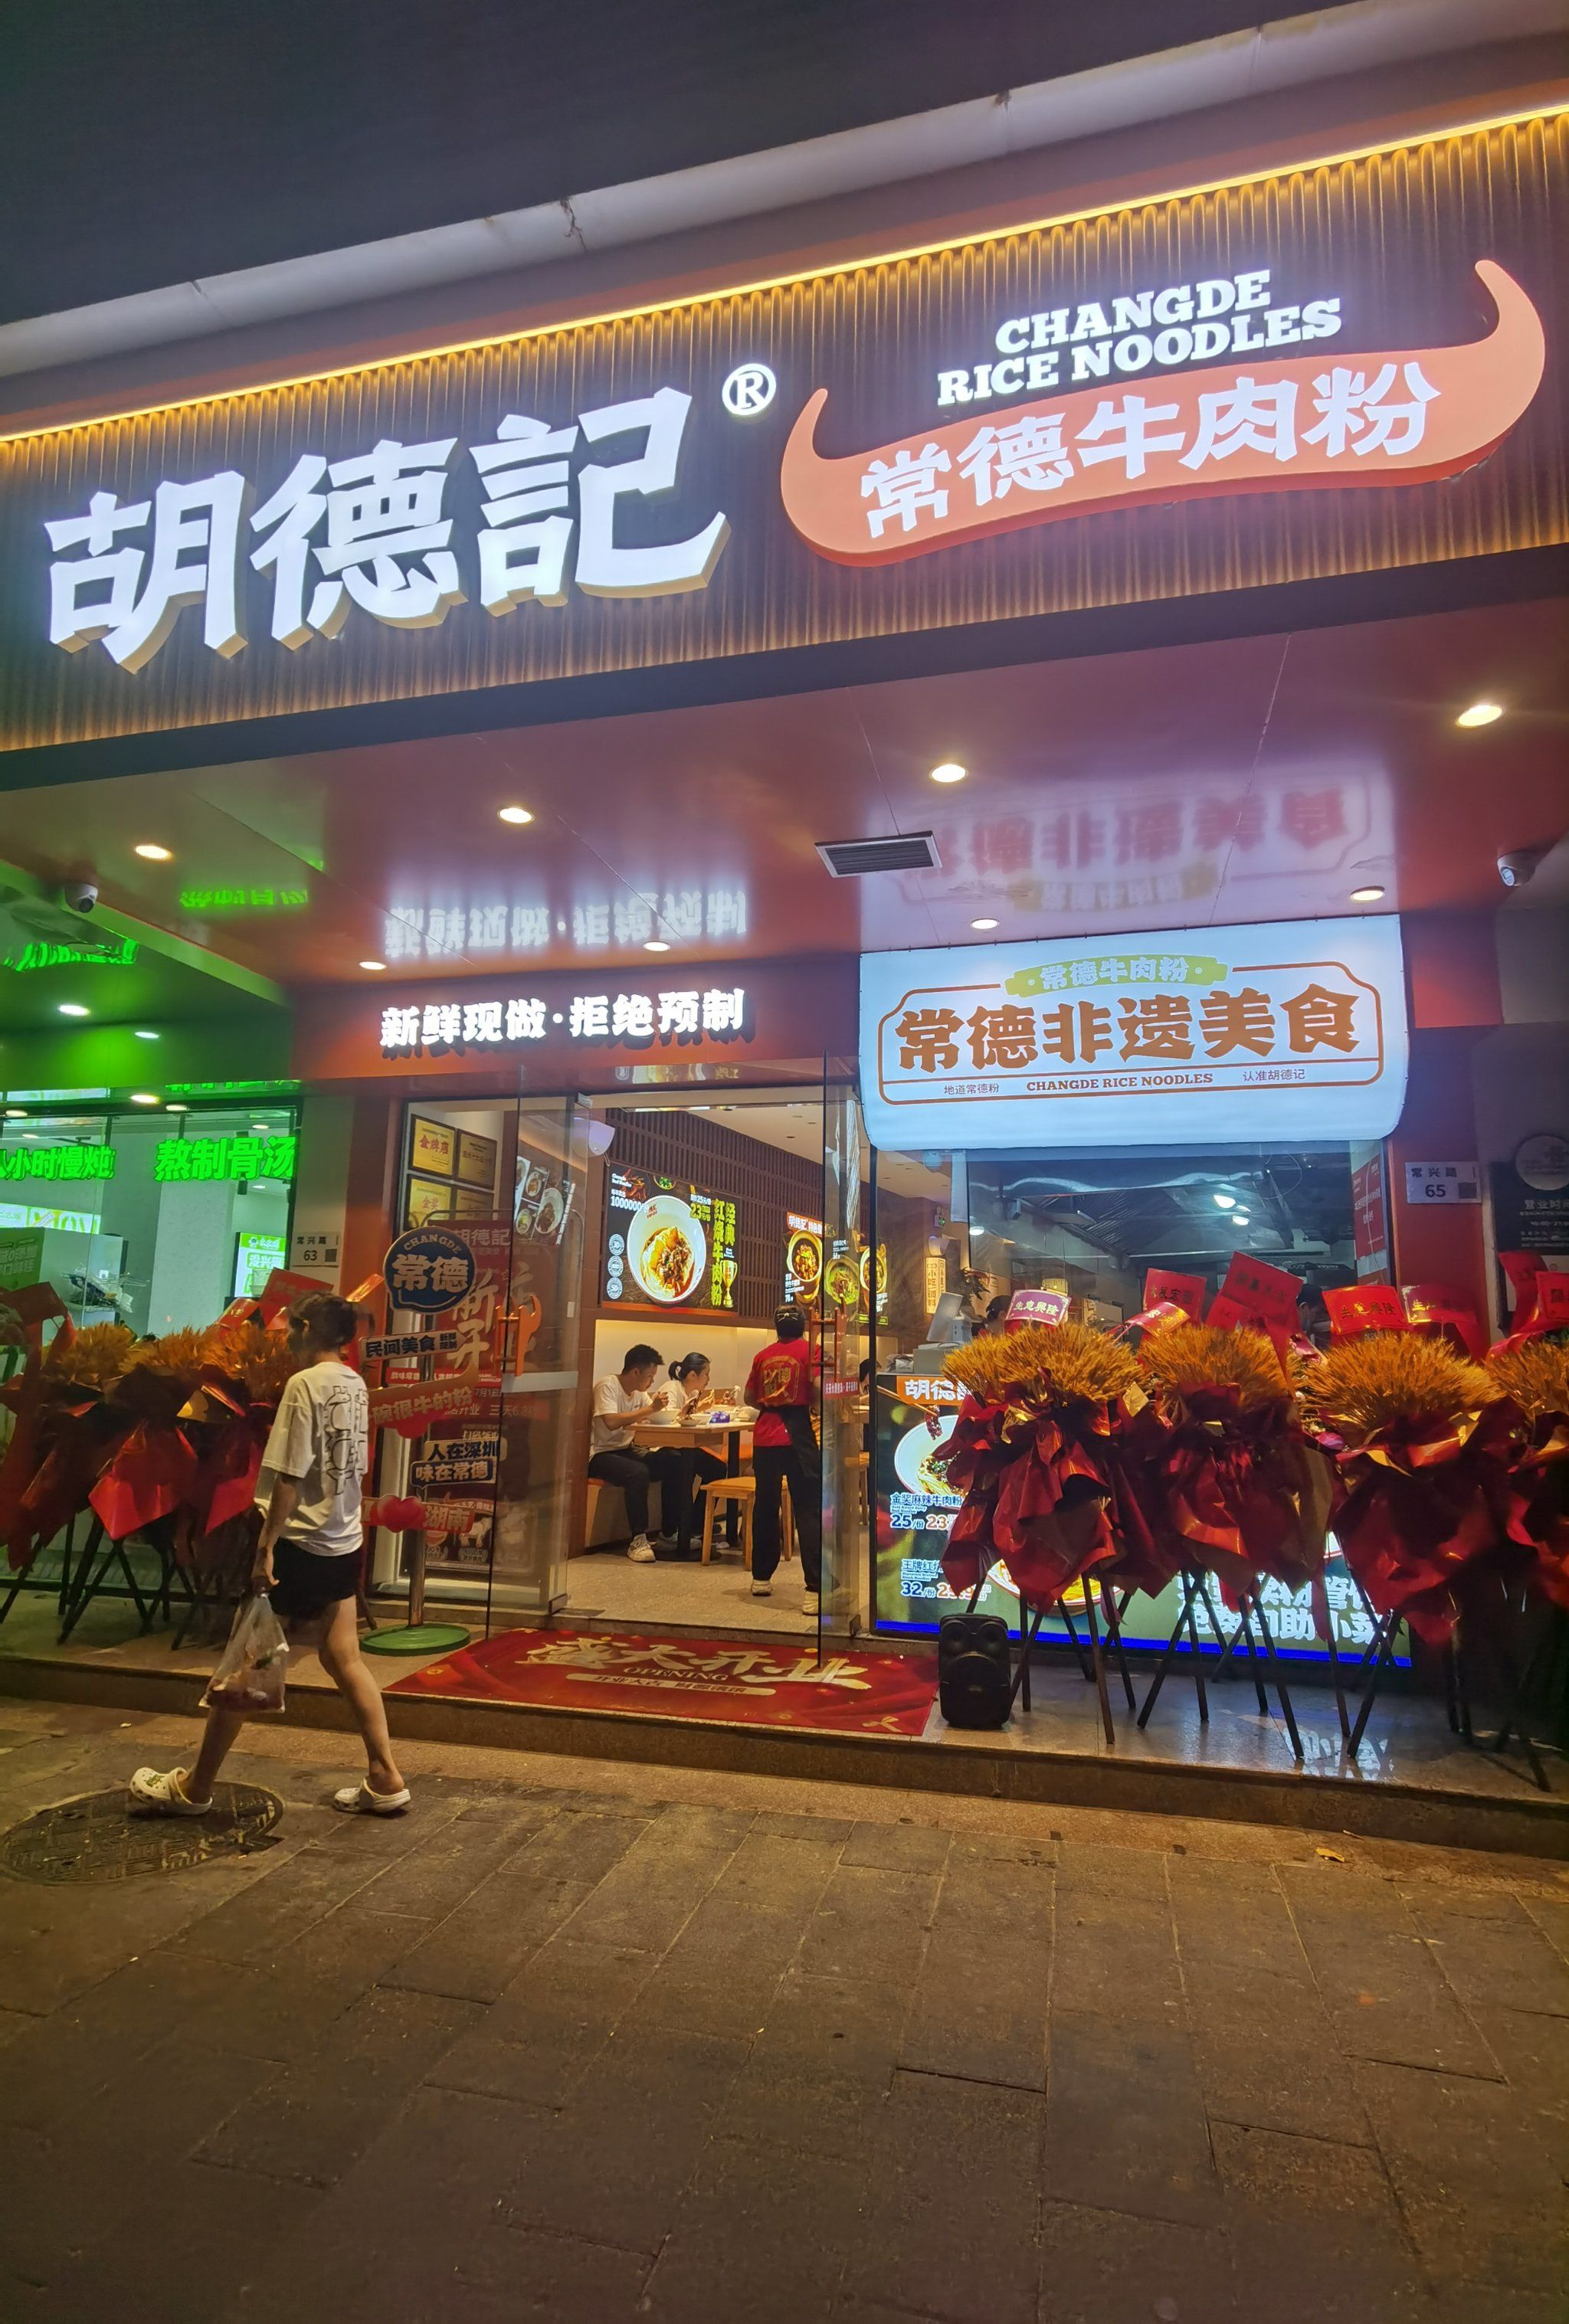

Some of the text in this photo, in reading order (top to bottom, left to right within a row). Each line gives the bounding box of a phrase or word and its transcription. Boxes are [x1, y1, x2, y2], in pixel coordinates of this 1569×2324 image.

[995, 270, 1273, 355] CHANGDE
[936, 299, 1342, 407] RICE NOODLES
[860, 362, 1441, 539] 常德牛肉粉
[44, 386, 731, 673] 胡德記
[1040, 954, 1188, 990] 常德牛肉粉
[380, 988, 745, 1048] 新鲜现做·拒绝预制
[894, 983, 1361, 1075] 常德非遗美食
[1027, 1072, 1214, 1092] CHANGDE RICE NOODLES
[1242, 1068, 1306, 1083] 认准胡德记
[943, 1082, 1000, 1095] 地道常德粉
[155, 1136, 297, 1182] 熬制骨汤
[1424, 1183, 1446, 1198] 65
[303, 1249, 318, 1262] 63
[404, 1234, 463, 1254] CHANGDE
[392, 1253, 469, 1293] 常德
[365, 1334, 436, 1359] 民间美食
[427, 1440, 500, 1462] 人在深圳
[414, 1461, 489, 1483] 味在常德
[890, 1491, 963, 1507] 金奖麻辣牛肉粉
[424, 1504, 471, 1531] 湖南
[623, 1666, 729, 1682] OPENING
